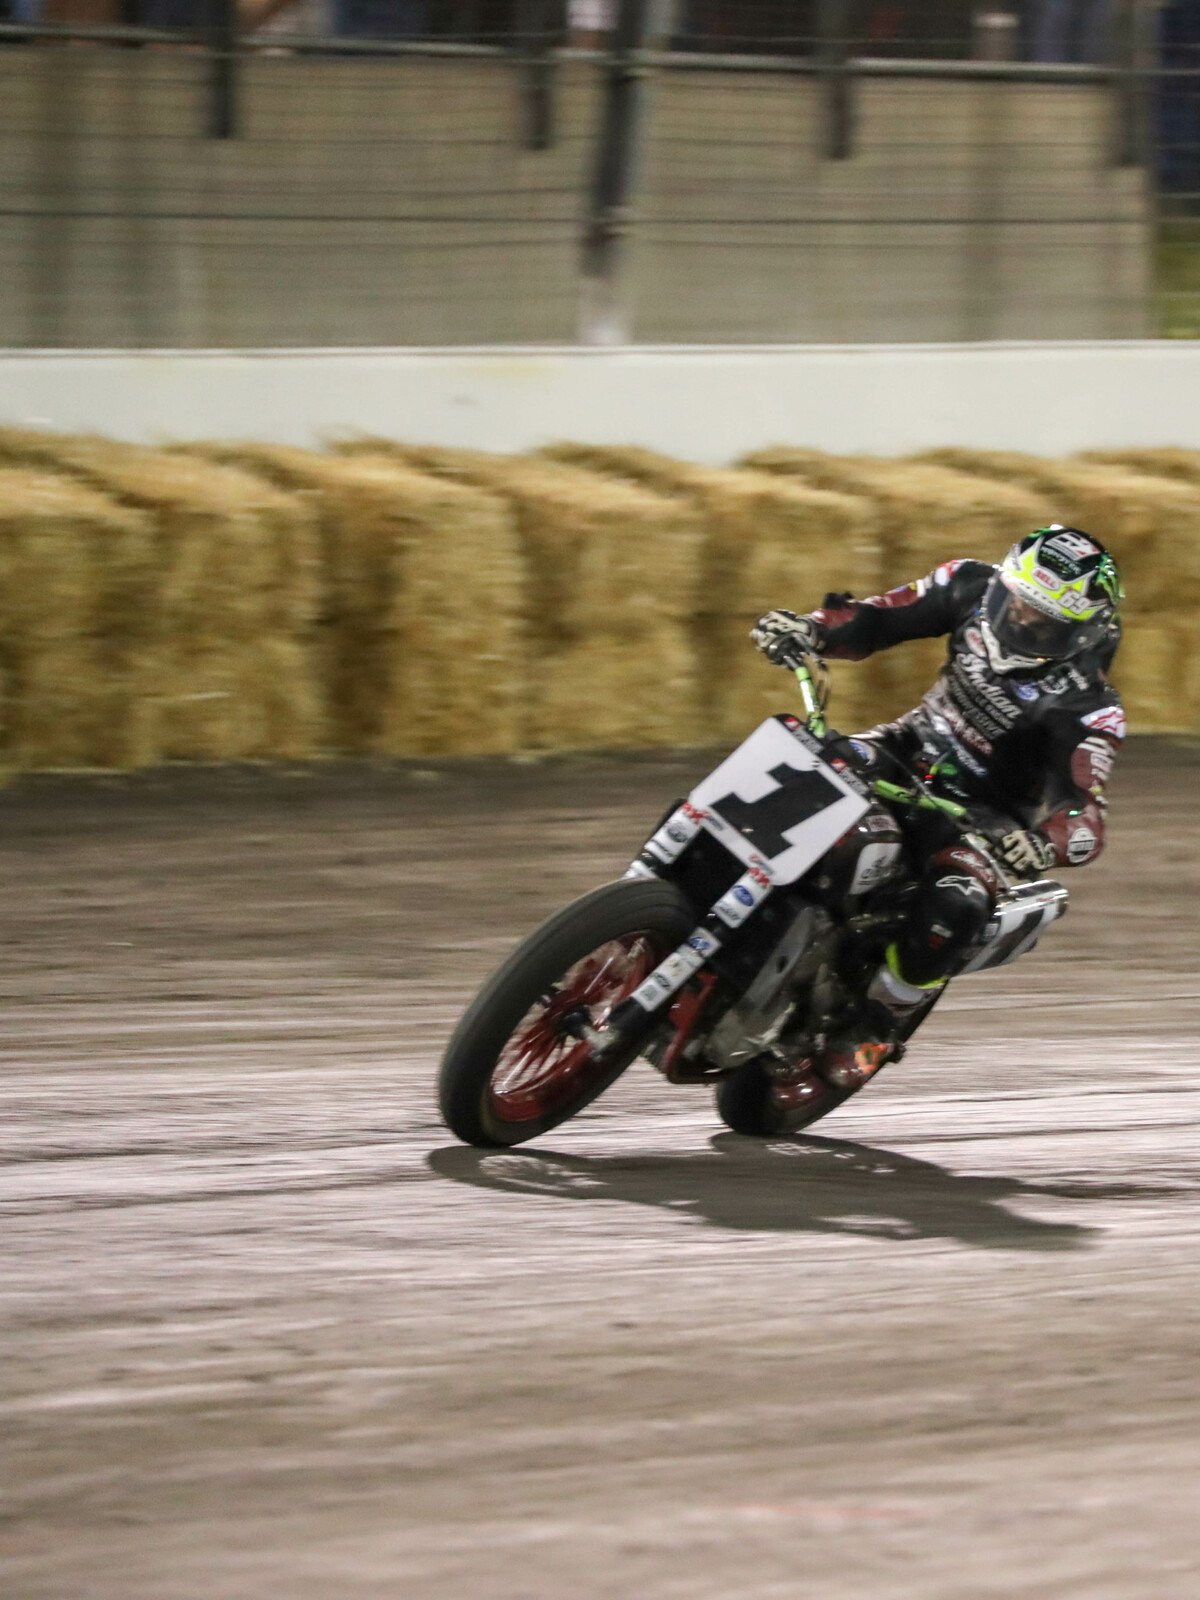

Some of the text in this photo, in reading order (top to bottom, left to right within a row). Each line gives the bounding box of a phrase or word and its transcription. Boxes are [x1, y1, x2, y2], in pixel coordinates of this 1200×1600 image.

[1056, 589, 1091, 615] 69
[956, 653, 1023, 719] Indian
[709, 762, 847, 860] 1
